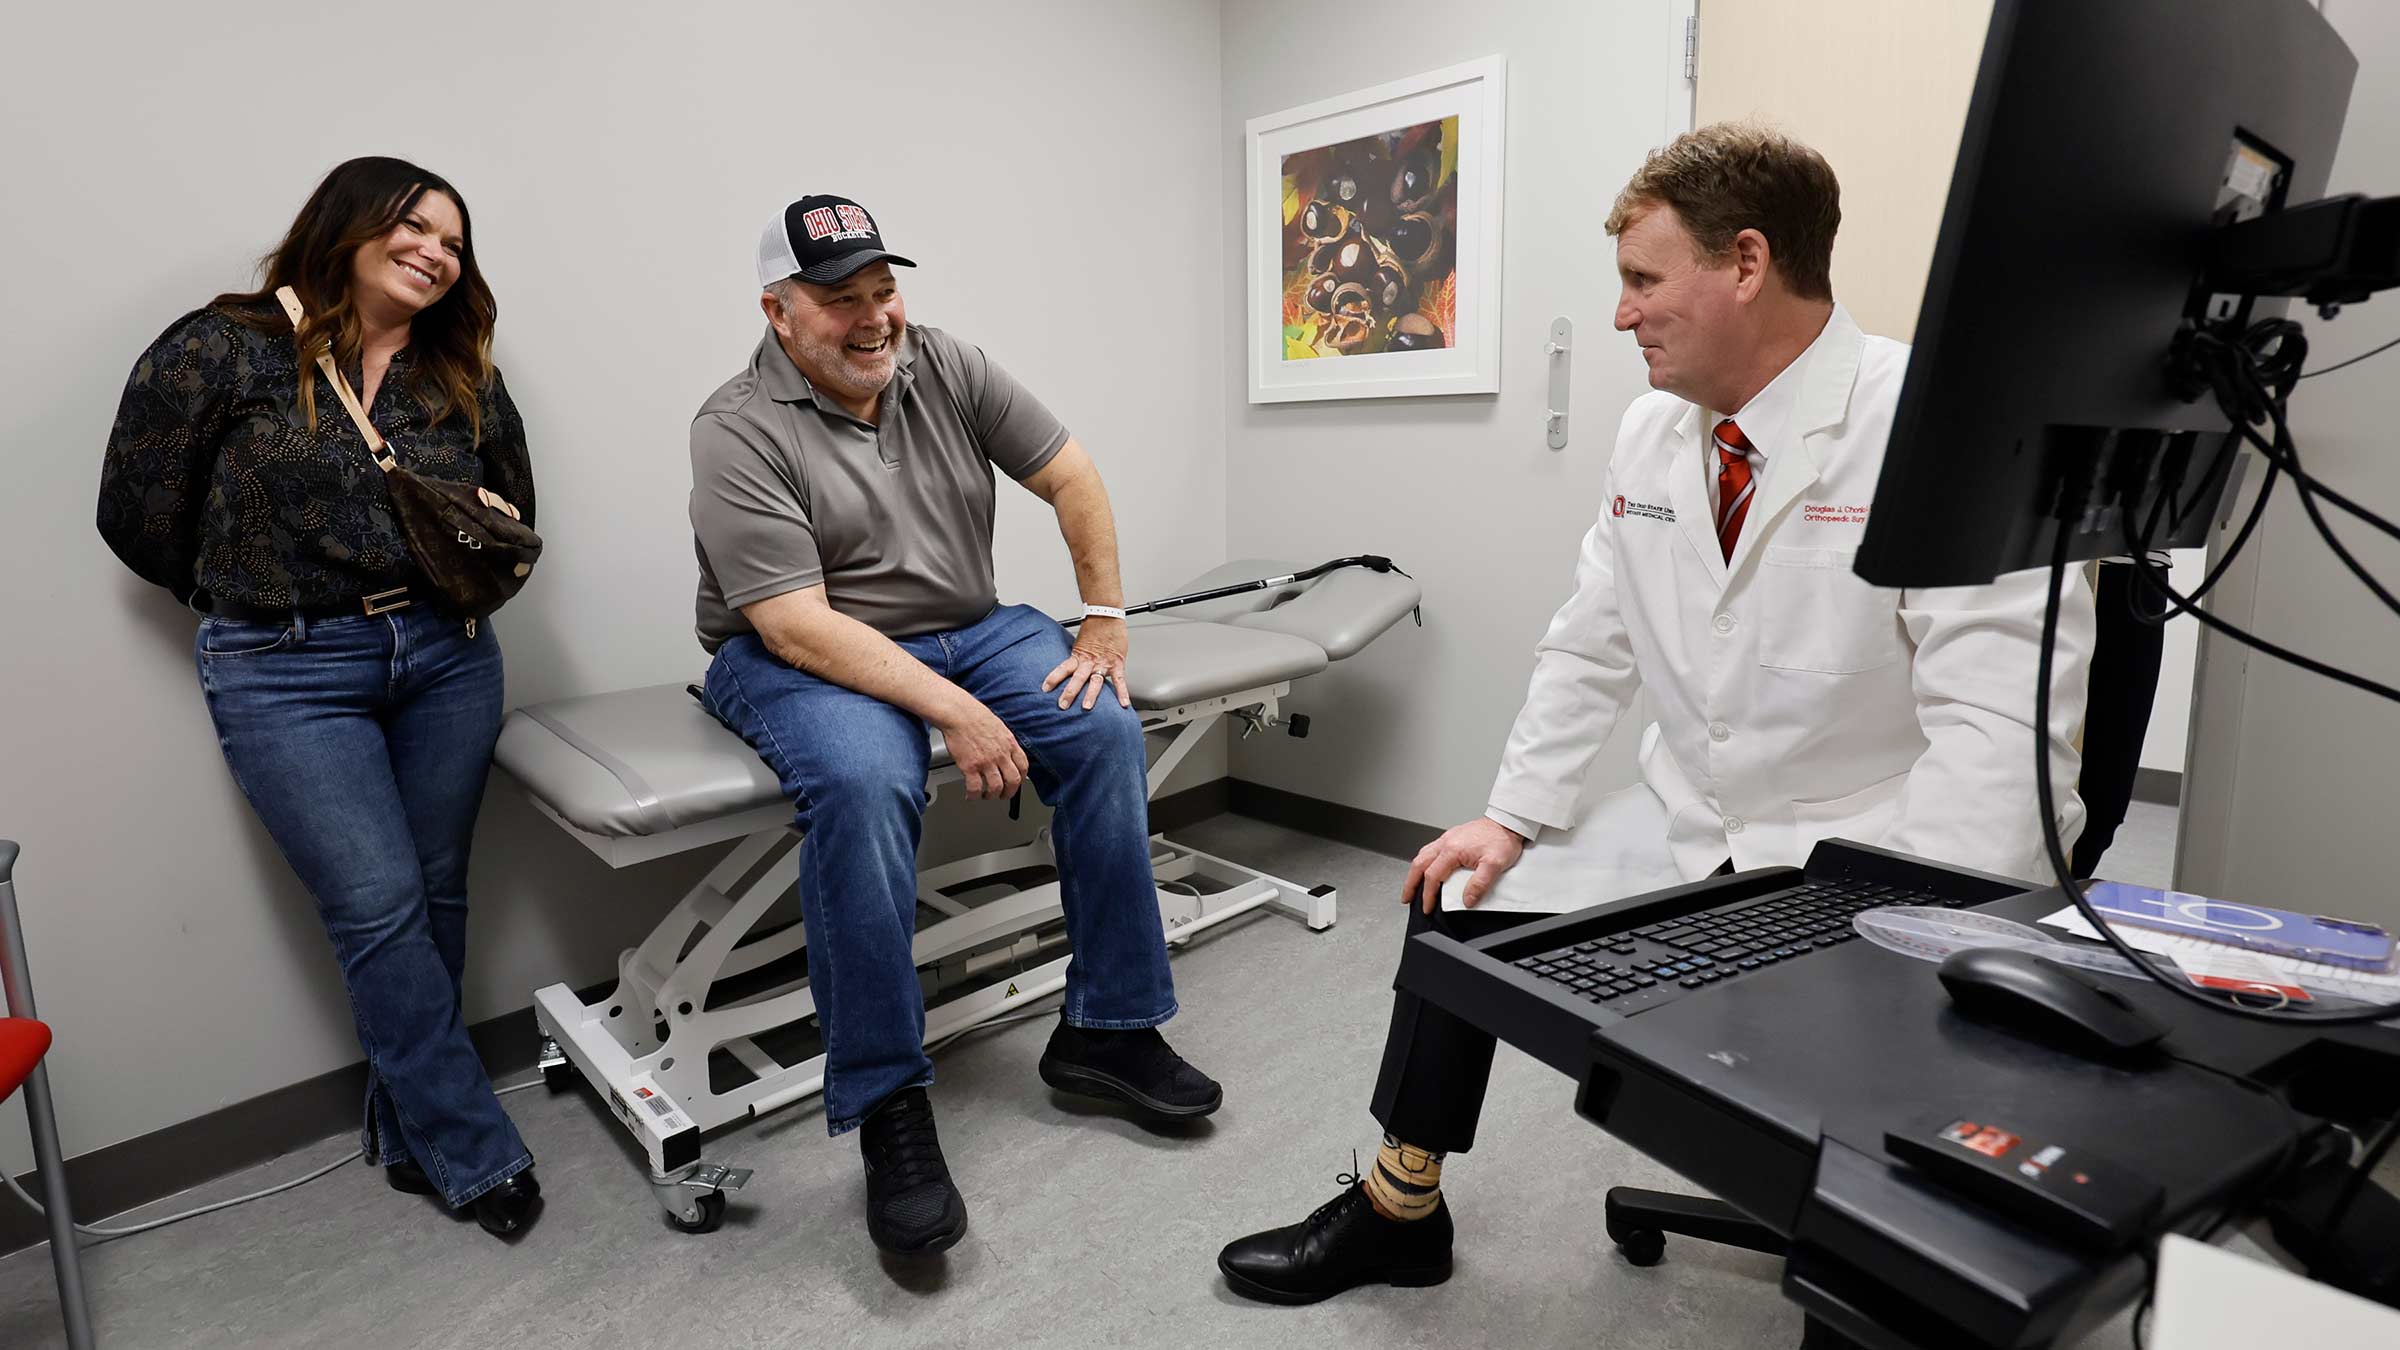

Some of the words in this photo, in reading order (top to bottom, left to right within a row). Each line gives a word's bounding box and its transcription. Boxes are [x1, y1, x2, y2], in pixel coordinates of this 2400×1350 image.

[803, 207, 840, 240] OHIO
[836, 205, 876, 234] STATE
[1805, 505, 1835, 513] Douglas
